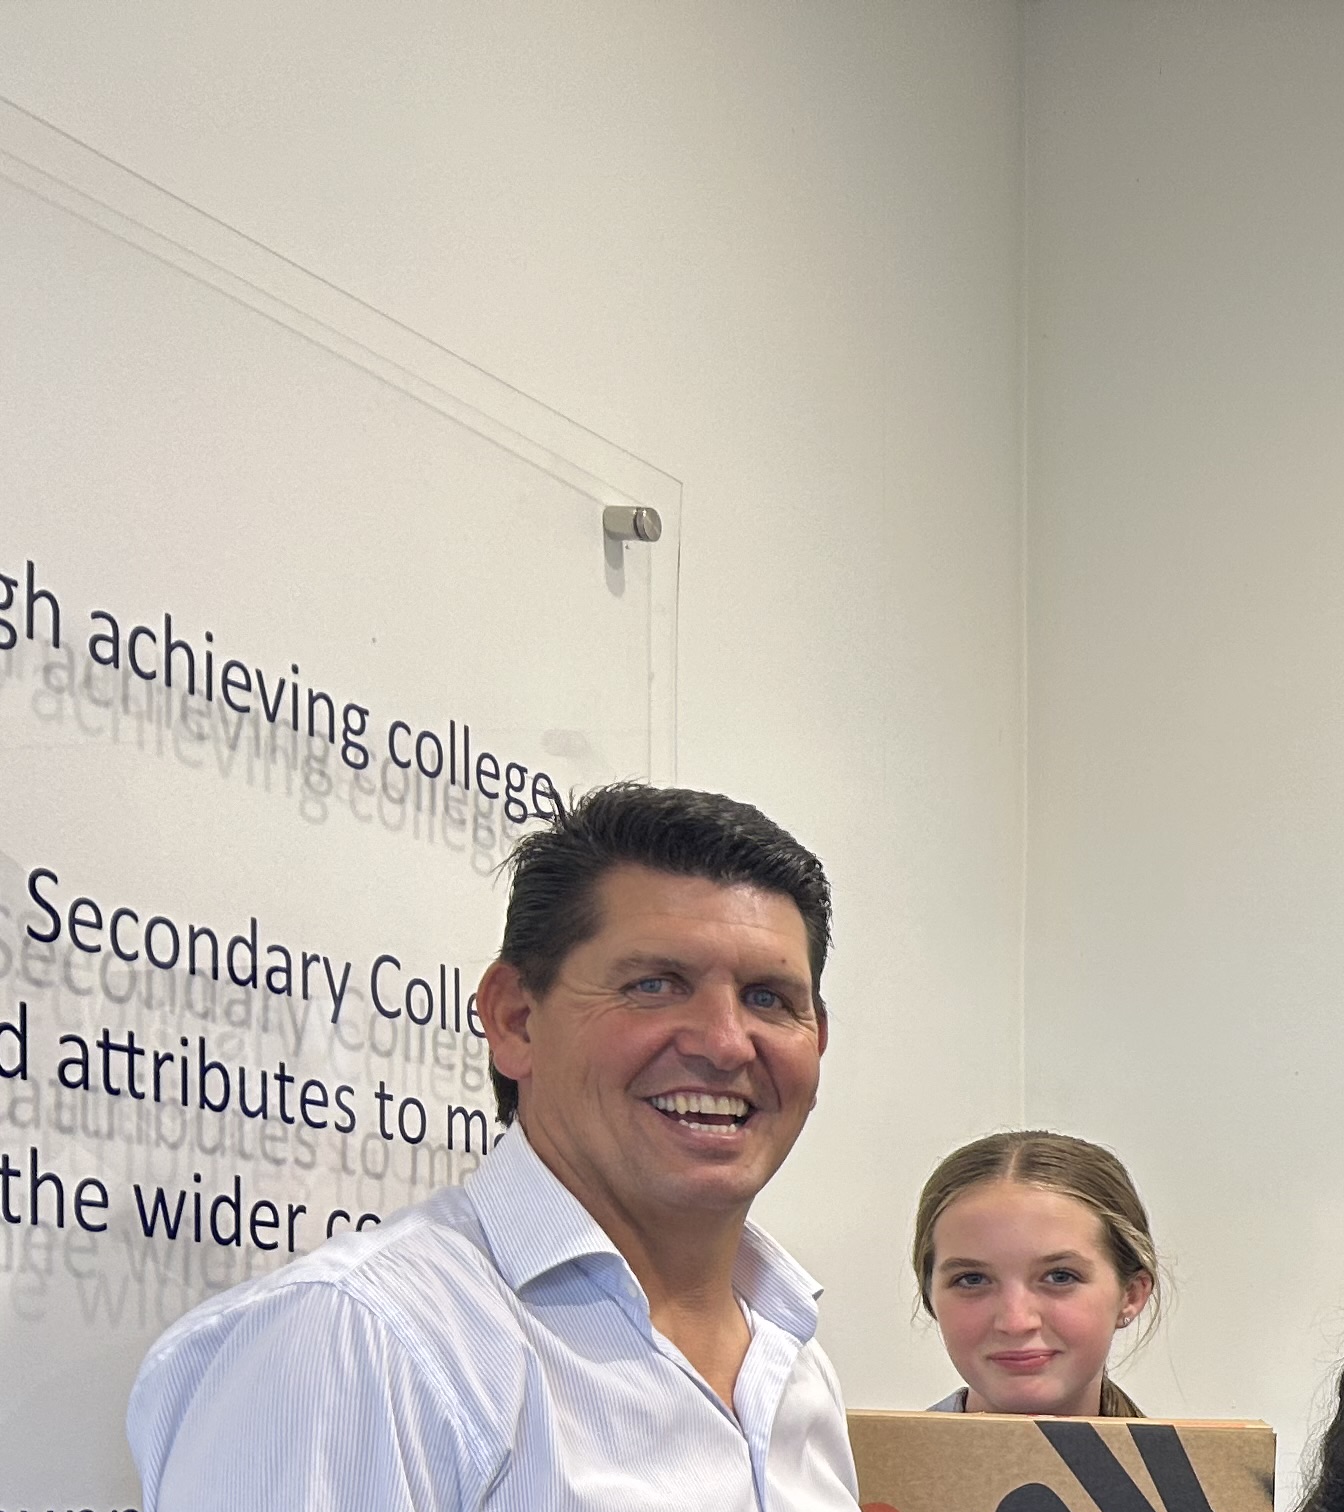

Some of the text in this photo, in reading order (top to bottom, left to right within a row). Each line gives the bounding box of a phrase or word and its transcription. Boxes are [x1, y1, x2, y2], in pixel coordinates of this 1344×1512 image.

[88, 609, 371, 770] achieving
[388, 720, 556, 824] college
[26, 867, 351, 1023] Secondary
[57, 1027, 356, 1134] attributes
[374, 1080, 427, 1144] to
[0, 1146, 109, 1233] the
[133, 1173, 307, 1253] wider
